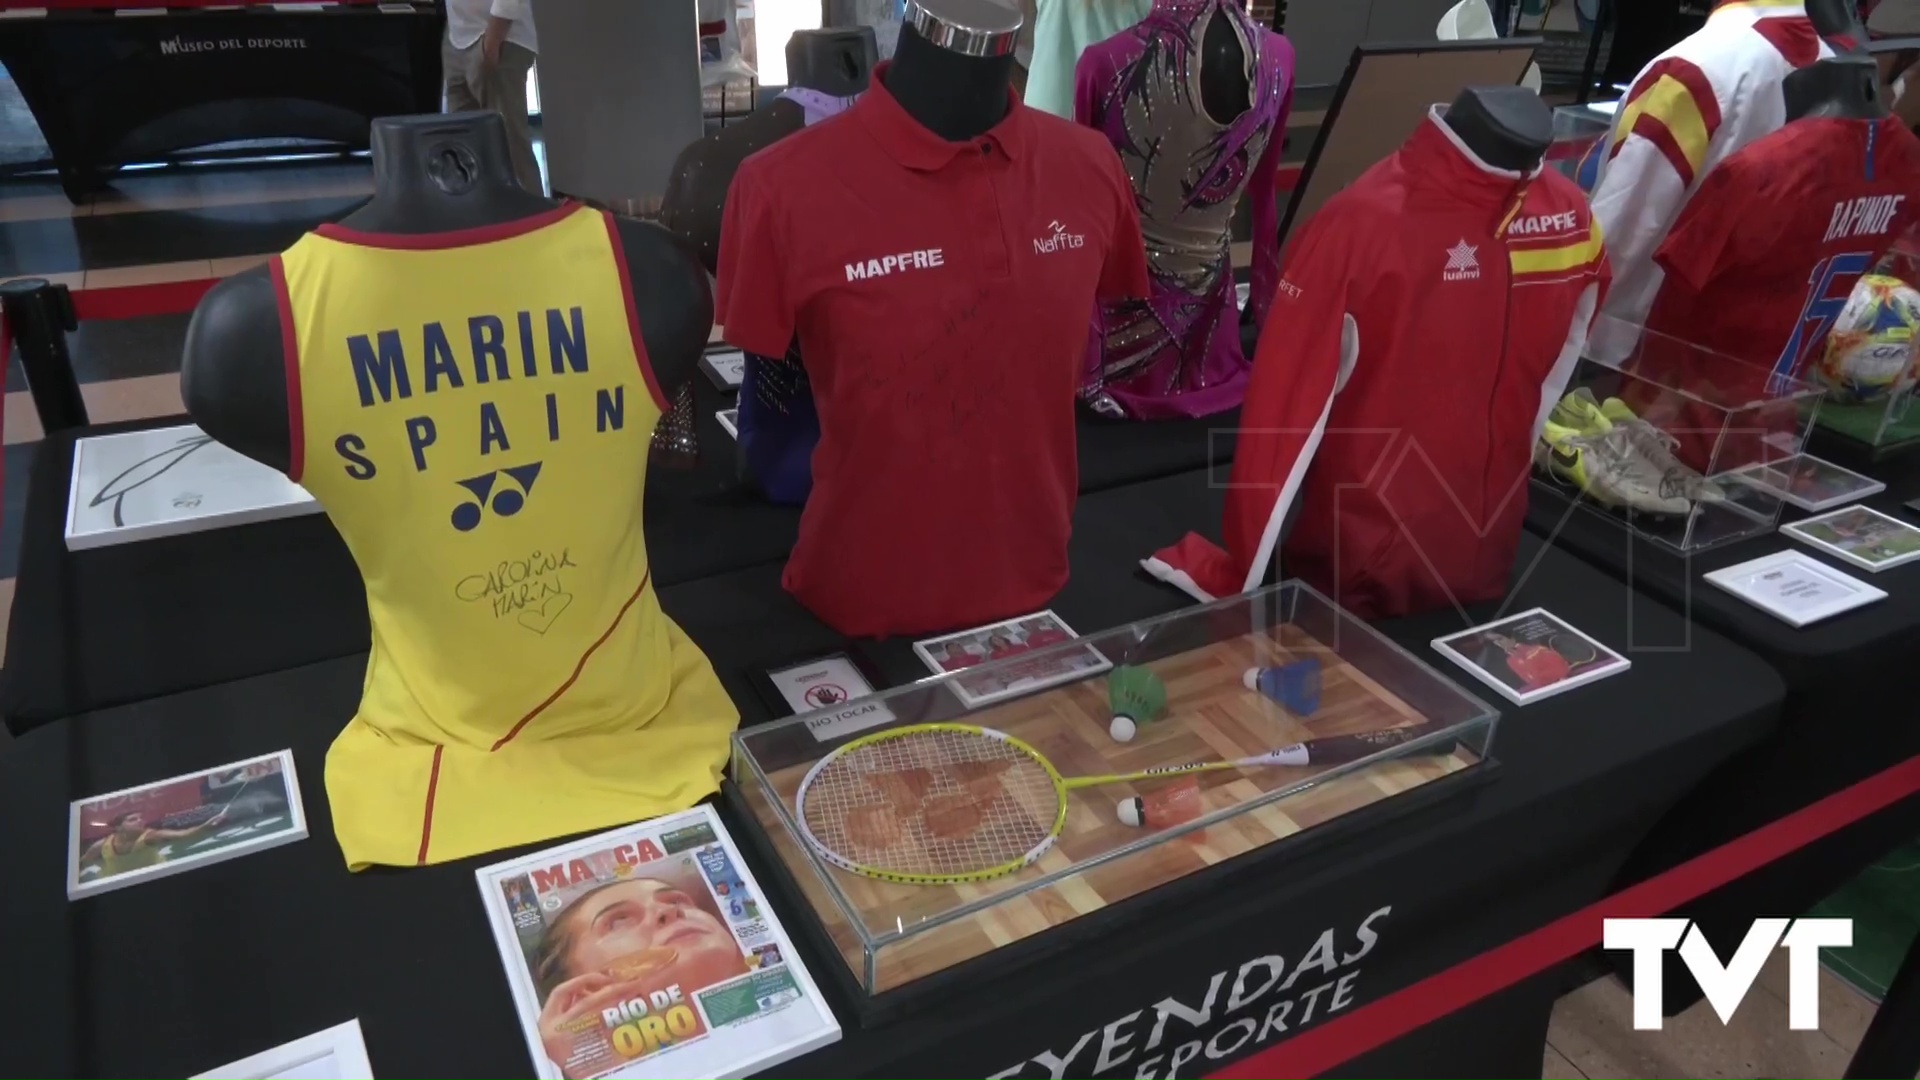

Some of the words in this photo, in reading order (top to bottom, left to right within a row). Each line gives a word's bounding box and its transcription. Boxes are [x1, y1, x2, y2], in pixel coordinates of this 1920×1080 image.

[160, 35, 215, 54] MUSEO
[219, 39, 244, 50] DEL
[248, 38, 307, 49] DEPORTE
[1033, 233, 1084, 255] Naffta
[845, 249, 944, 281] MAPFRE
[1443, 267, 1480, 281] luanvi
[346, 306, 589, 408] MARIN
[334, 385, 624, 480] SPAIN
[810, 717, 831, 729] NO
[835, 704, 878, 722] TOCAR
[531, 838, 663, 893] MARCA
[650, 983, 685, 1010] DE
[612, 1004, 697, 1057] ORO
